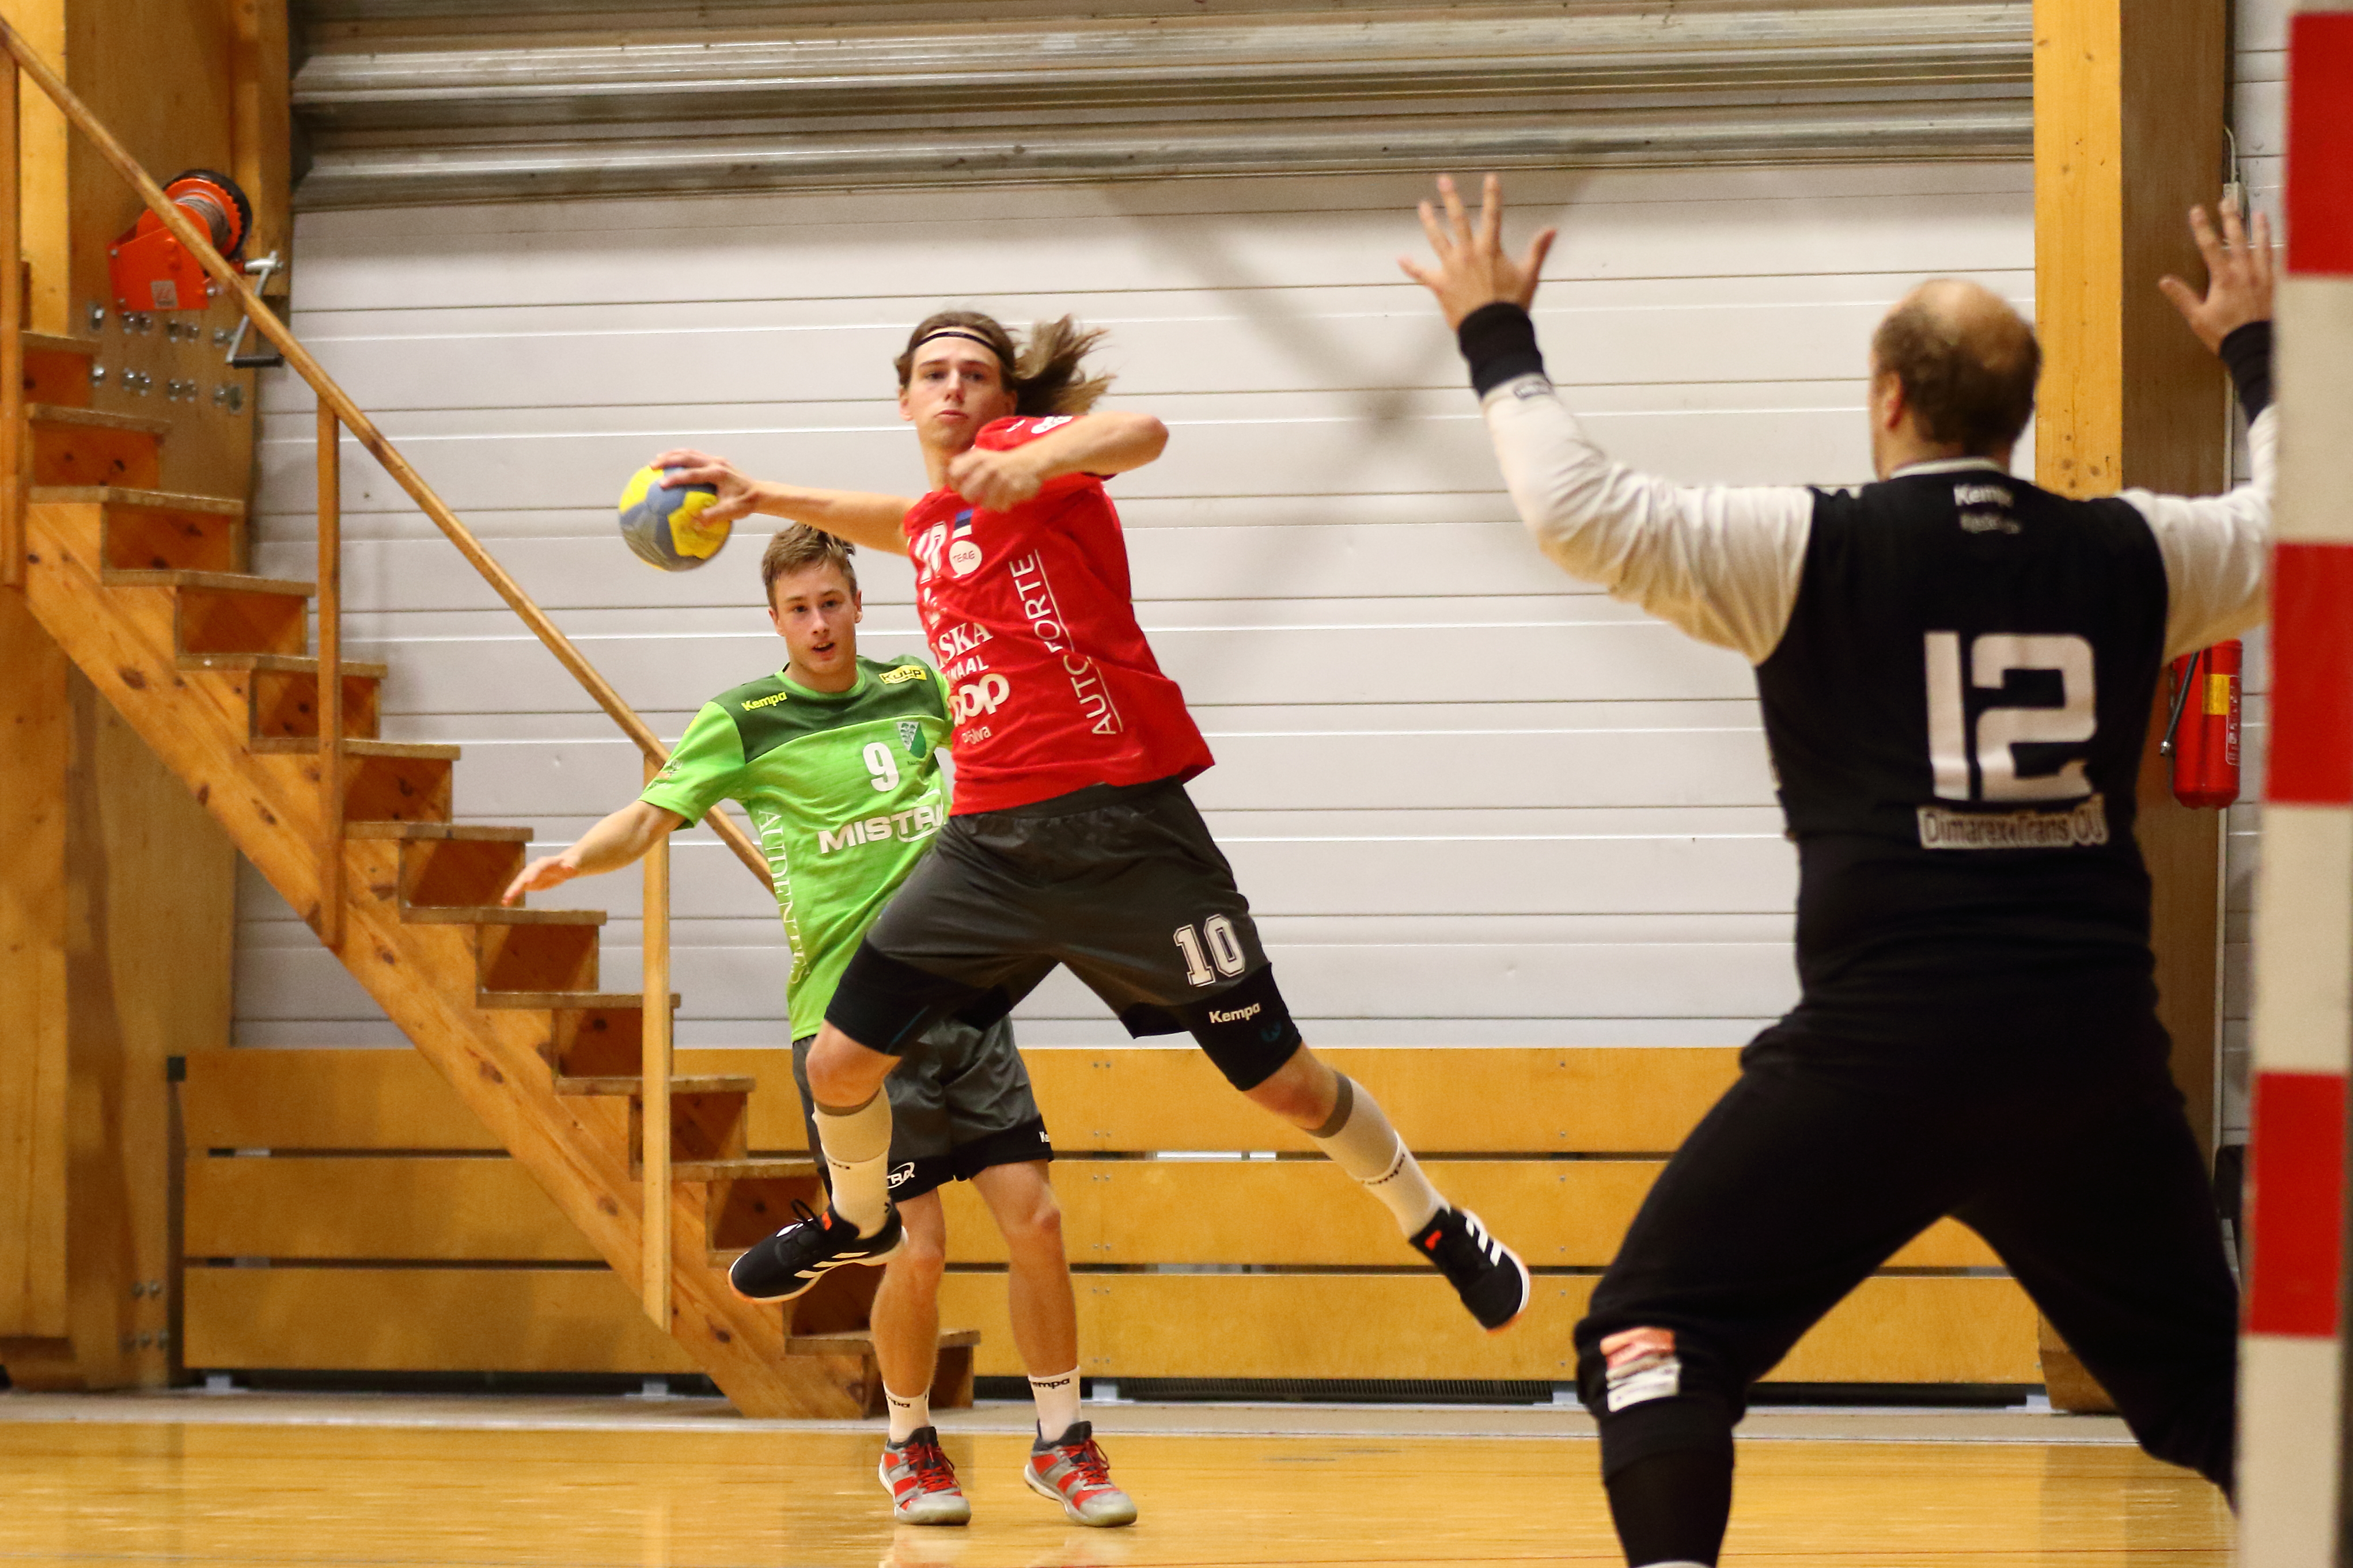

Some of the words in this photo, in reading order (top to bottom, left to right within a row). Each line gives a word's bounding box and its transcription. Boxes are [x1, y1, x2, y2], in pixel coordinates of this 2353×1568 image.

[953, 550, 975, 563] TERE
[741, 692, 787, 711] Kempa
[1924, 631, 2097, 801] 12
[862, 742, 900, 792] 9
[1173, 914, 1245, 987] 10
[1209, 1003, 1261, 1023] Kempa
